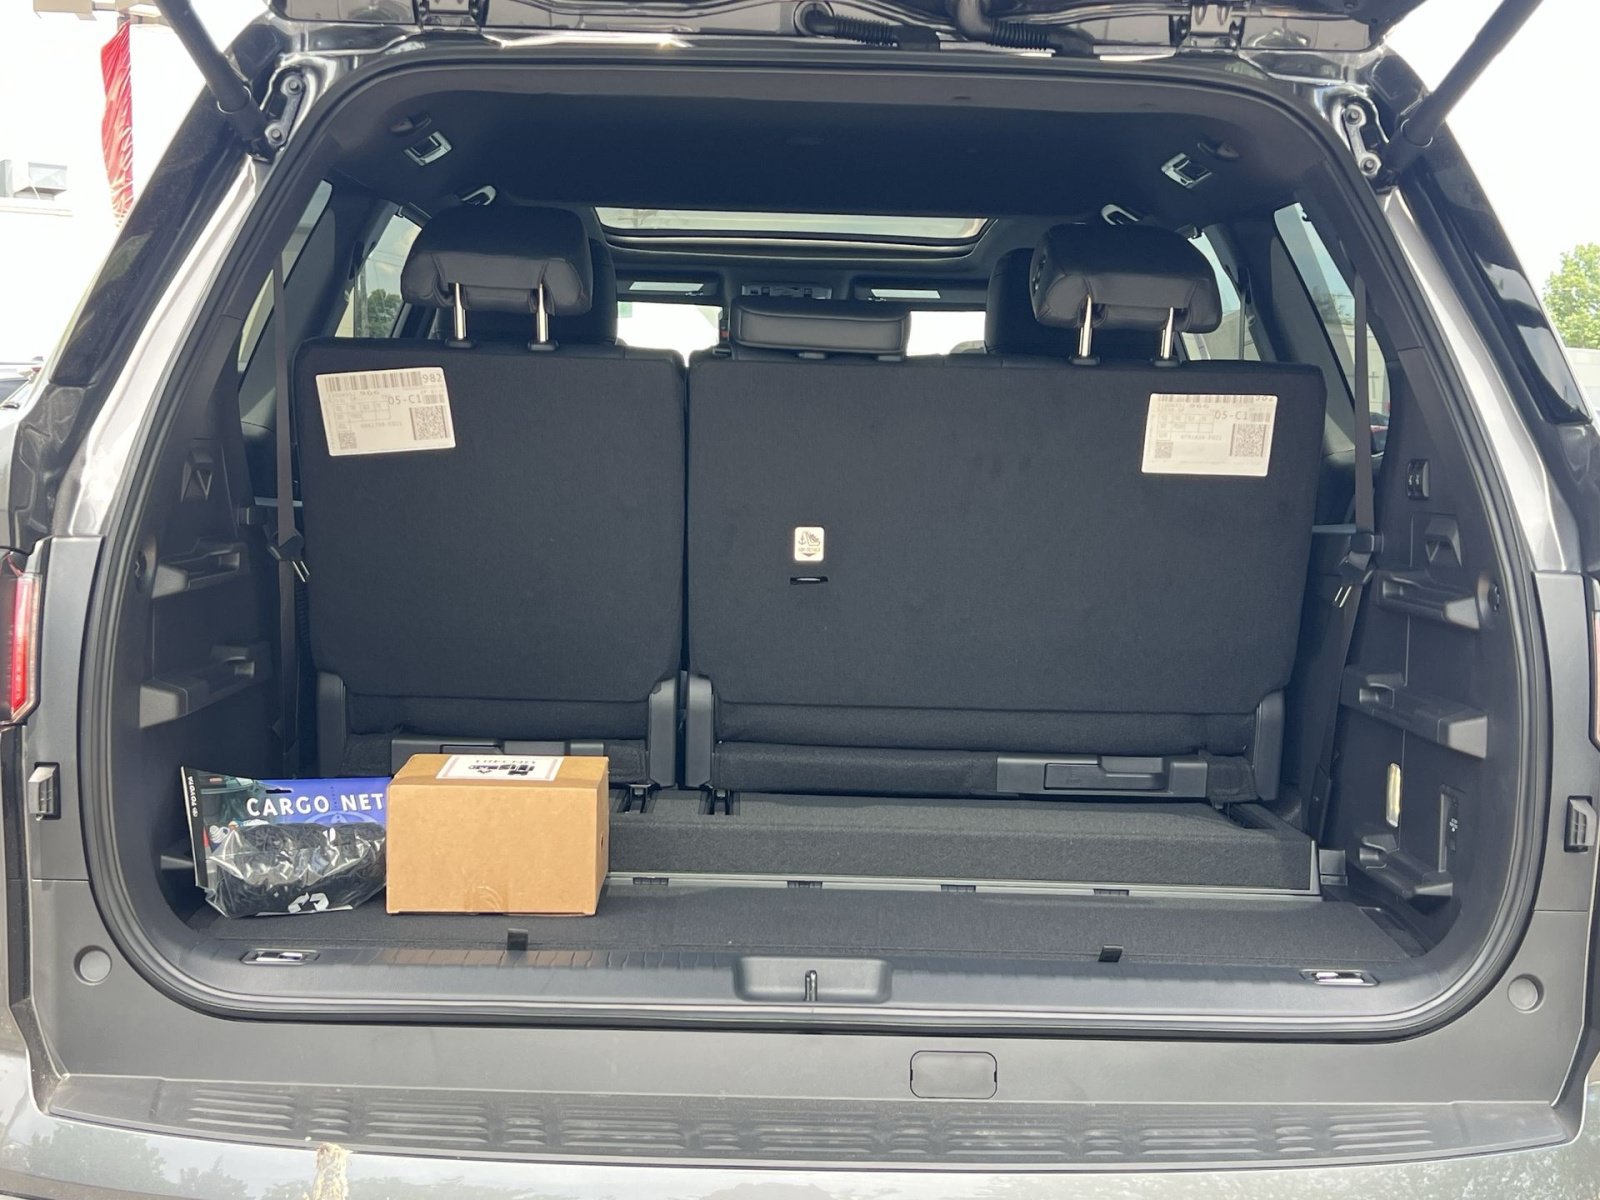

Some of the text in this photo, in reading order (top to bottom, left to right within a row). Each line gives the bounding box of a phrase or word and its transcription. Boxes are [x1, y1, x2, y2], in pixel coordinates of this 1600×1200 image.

[422, 373, 441, 383] 982
[187, 776, 197, 806] TOYOTA
[246, 795, 330, 817] CARGO
[340, 793, 384, 811] NET
